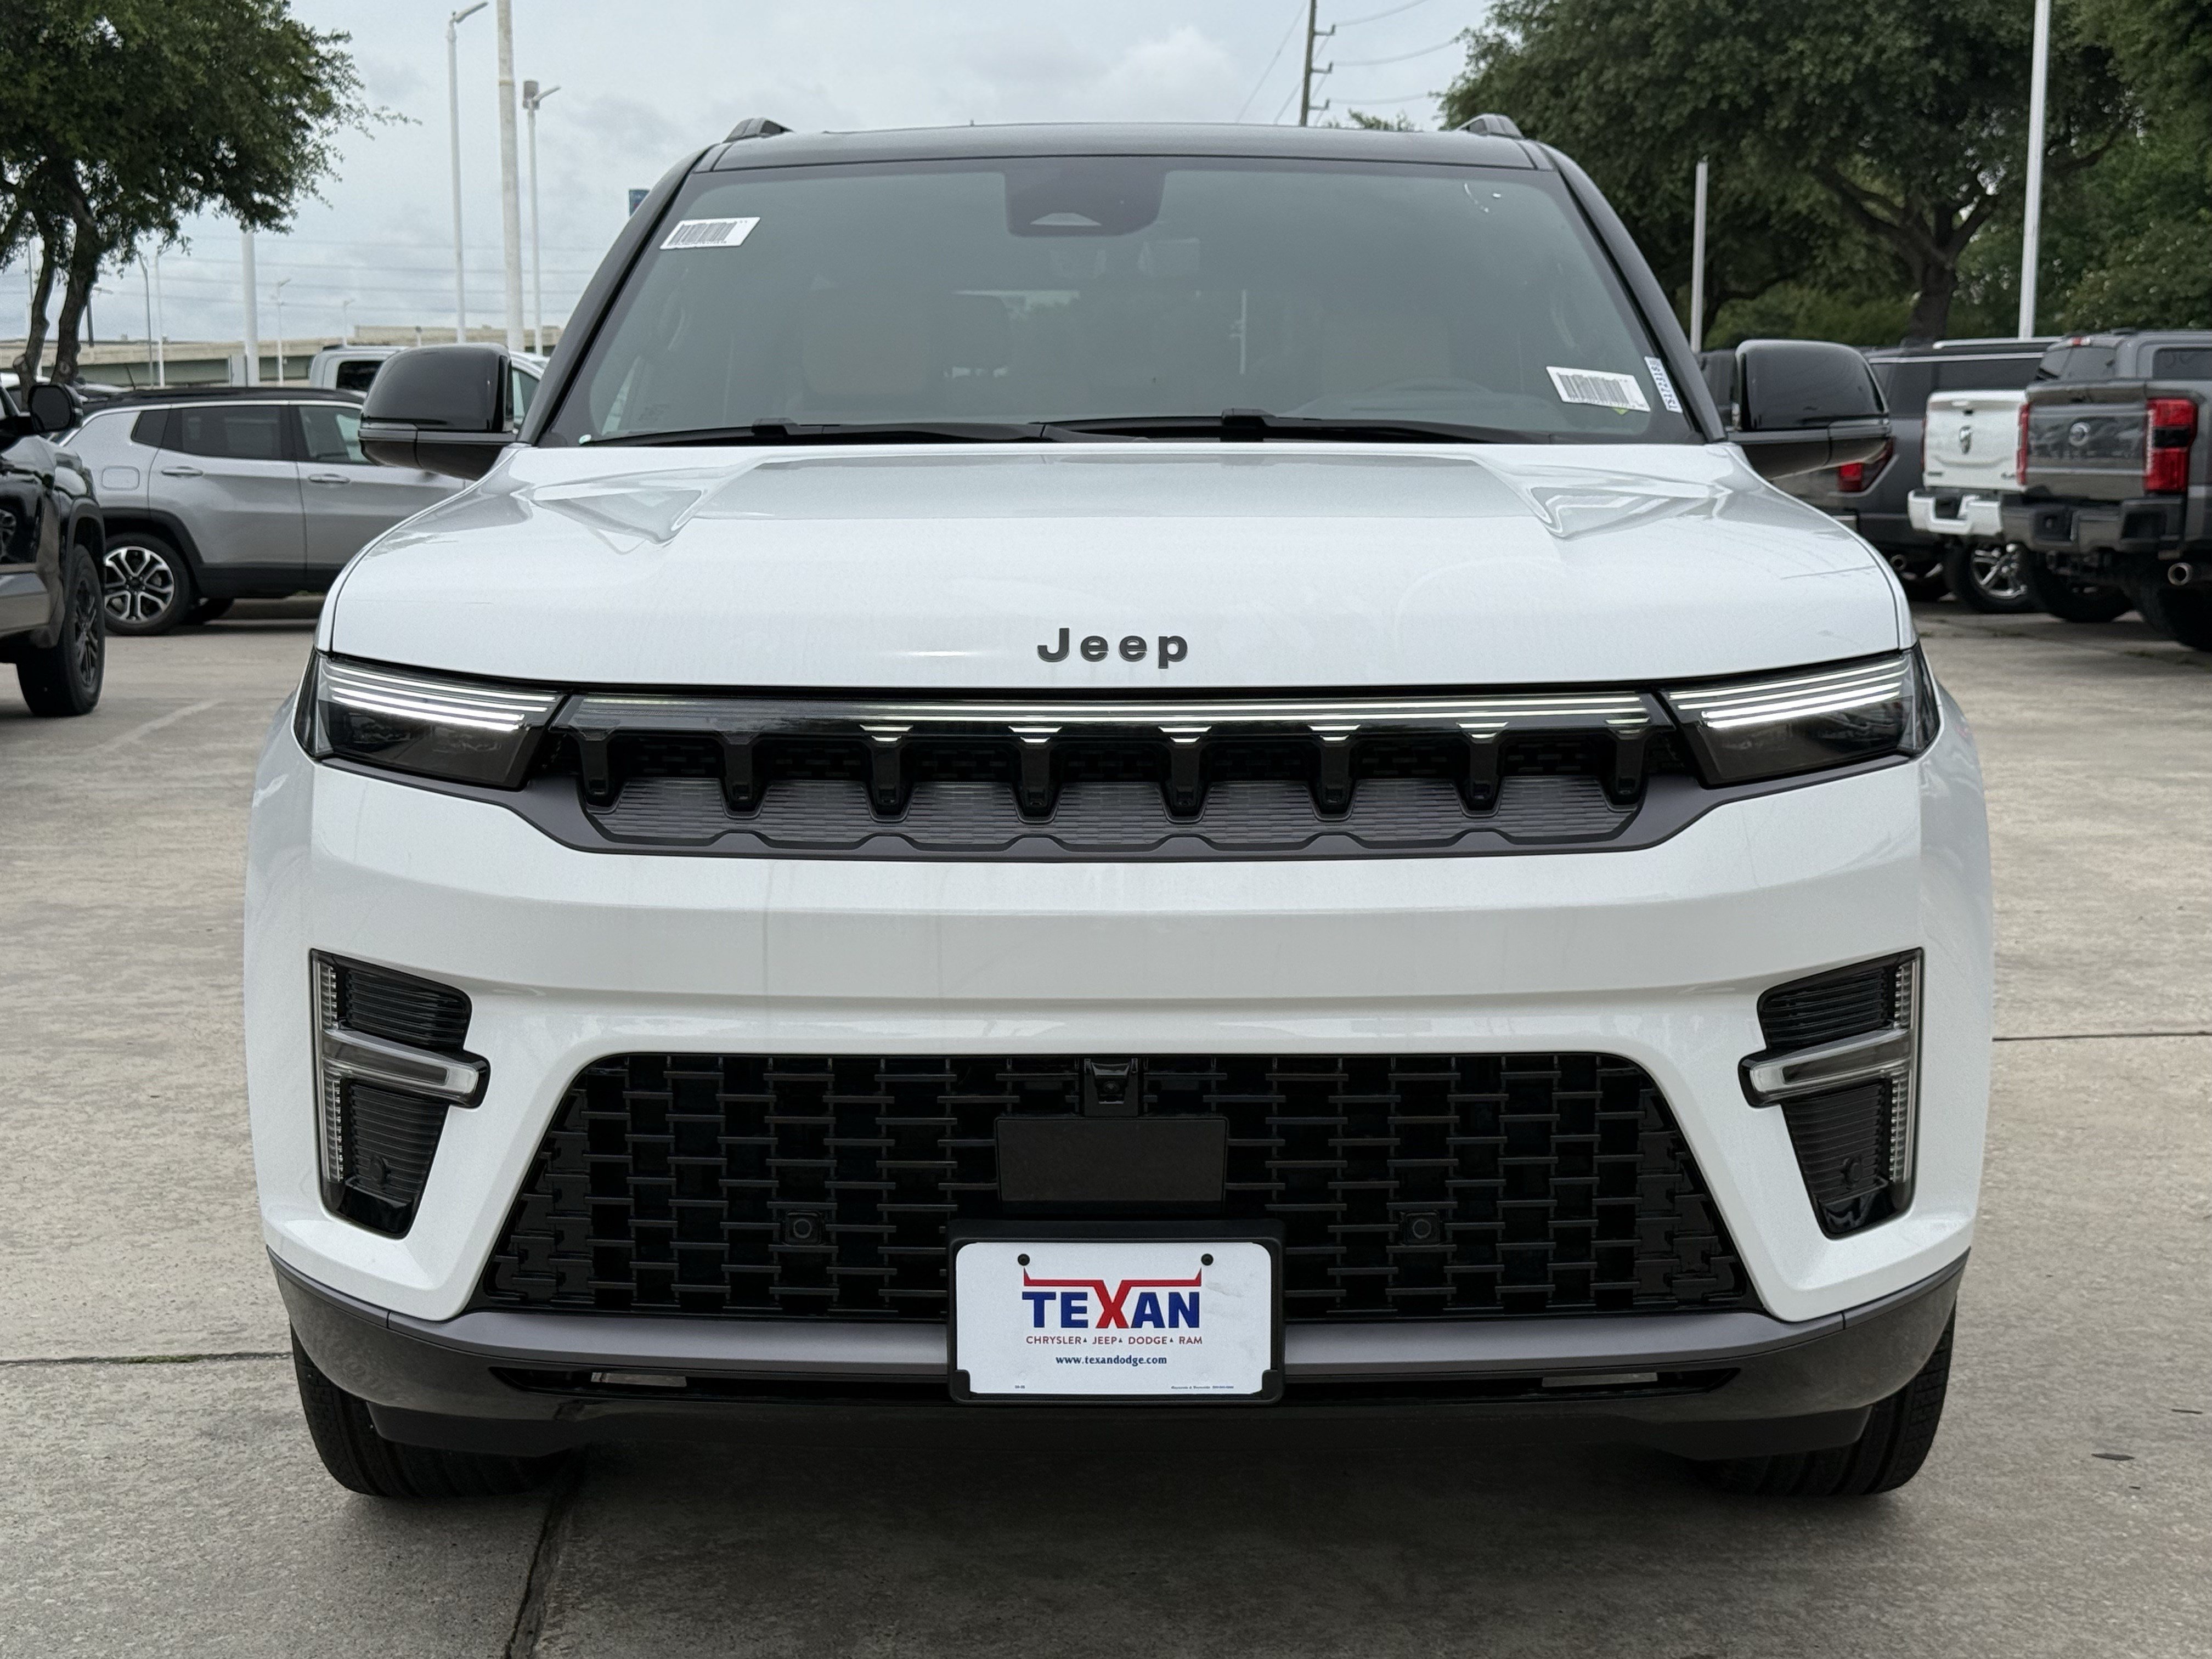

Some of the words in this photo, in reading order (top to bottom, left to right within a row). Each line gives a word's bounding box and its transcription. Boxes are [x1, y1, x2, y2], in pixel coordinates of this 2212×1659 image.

[1037, 628, 1188, 669] Jeep
[1022, 1278, 1201, 1329] TEXAN
[1026, 1336, 1082, 1345] CHRYSLER
[1092, 1336, 1117, 1345] JEEP
[1128, 1336, 1167, 1345] DODGE
[1179, 1336, 1203, 1345] RAM
[1056, 1355, 1167, 1367] www.texandodge.com
